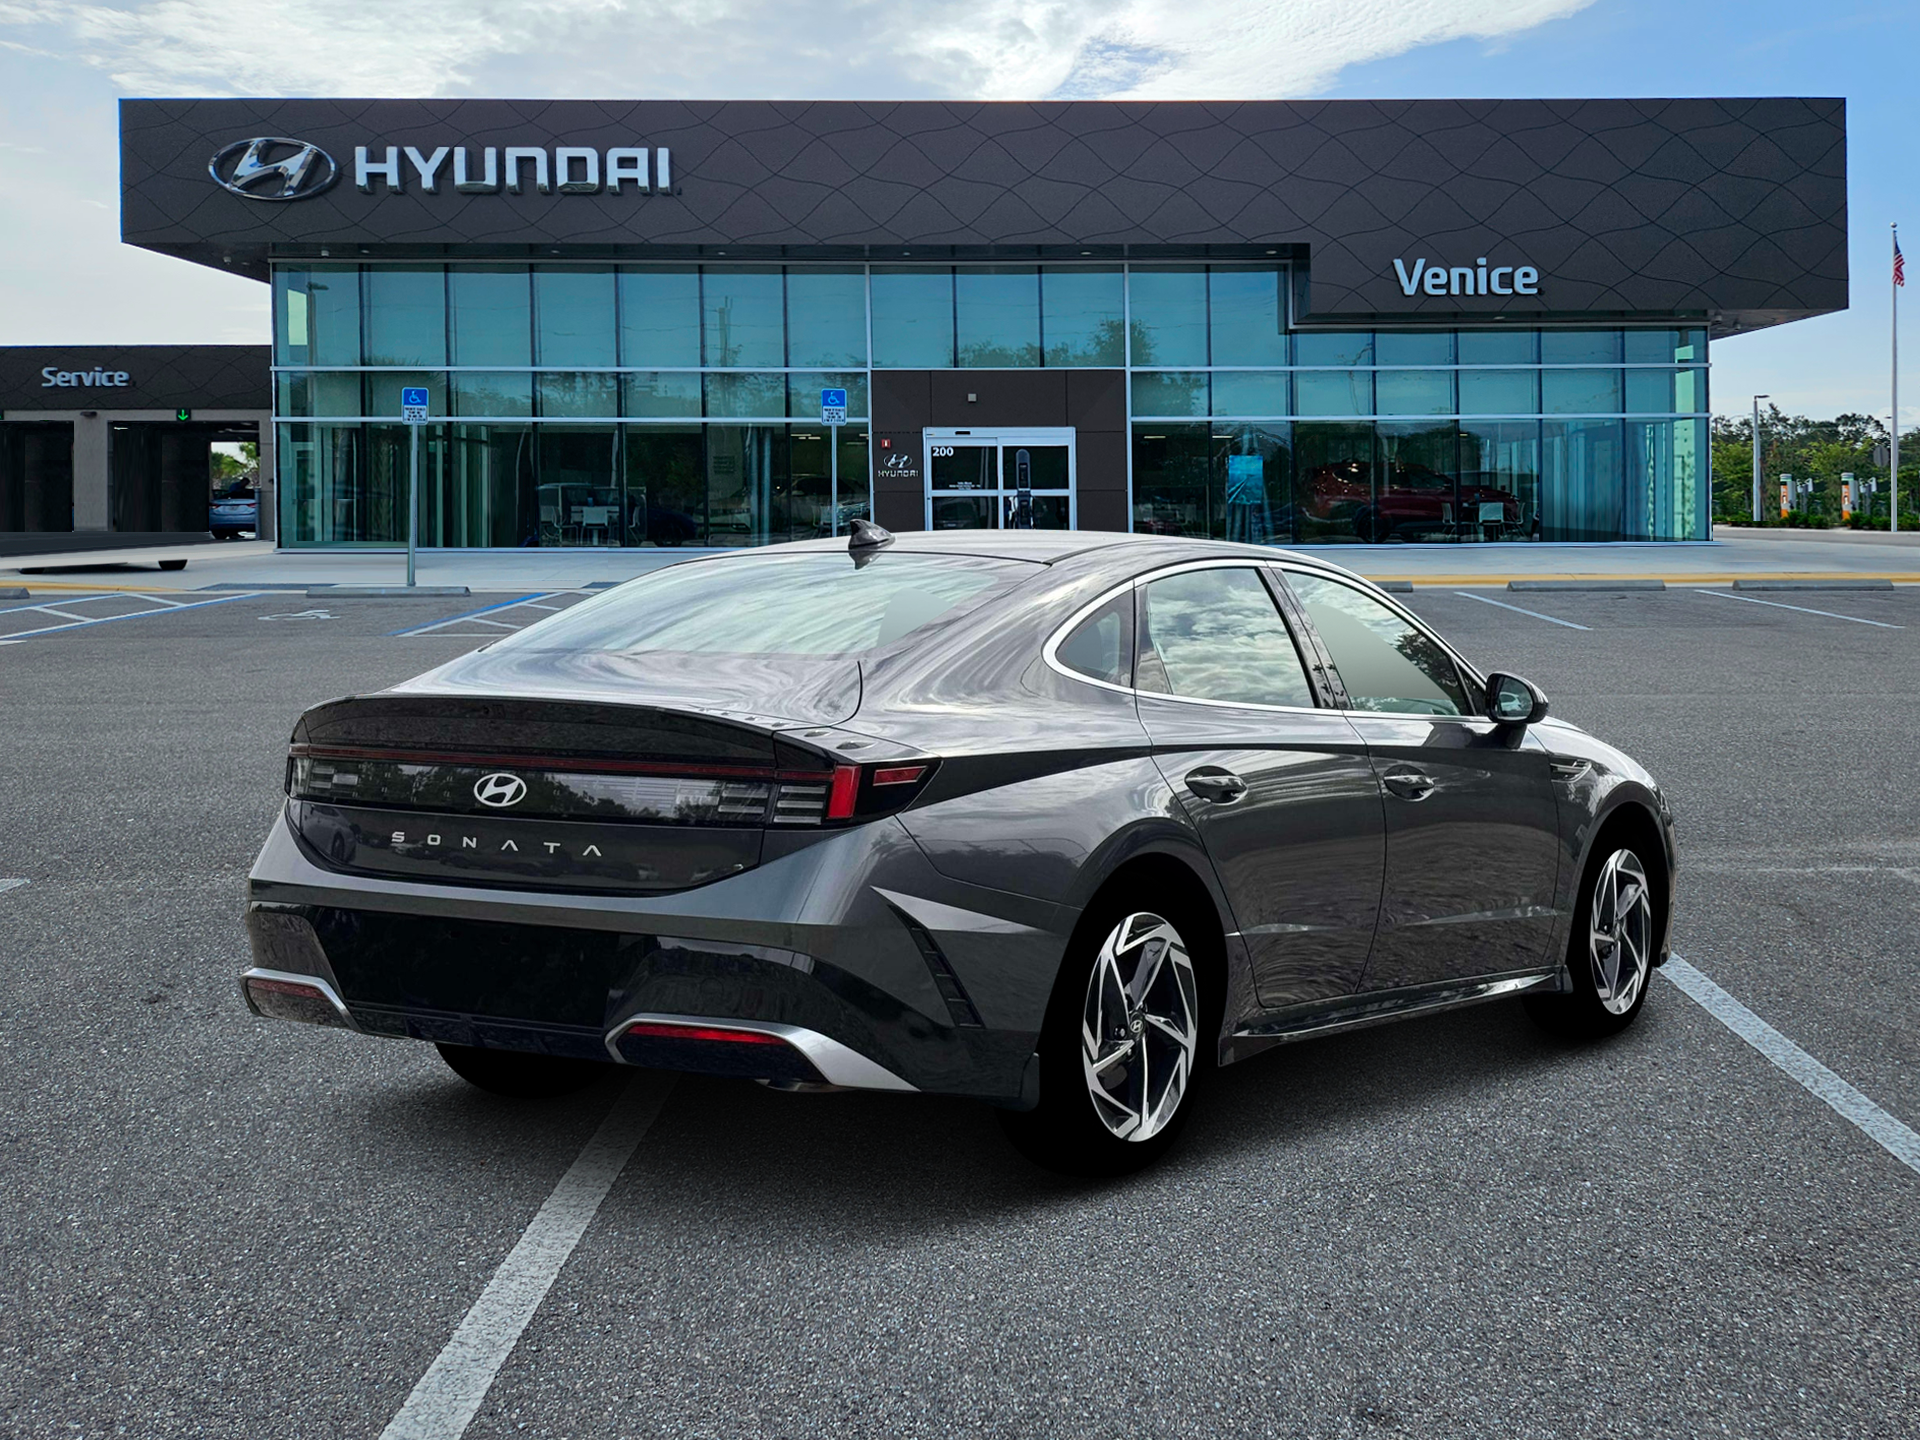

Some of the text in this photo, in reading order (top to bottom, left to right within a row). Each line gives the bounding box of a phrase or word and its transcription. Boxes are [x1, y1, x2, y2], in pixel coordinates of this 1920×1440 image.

[354, 146, 674, 194] HYUNDAI
[1393, 257, 1539, 295] Venice
[41, 366, 130, 387] Service
[932, 446, 954, 457] 200
[878, 470, 919, 478] HYUNDAI
[390, 830, 602, 857] SONATA
